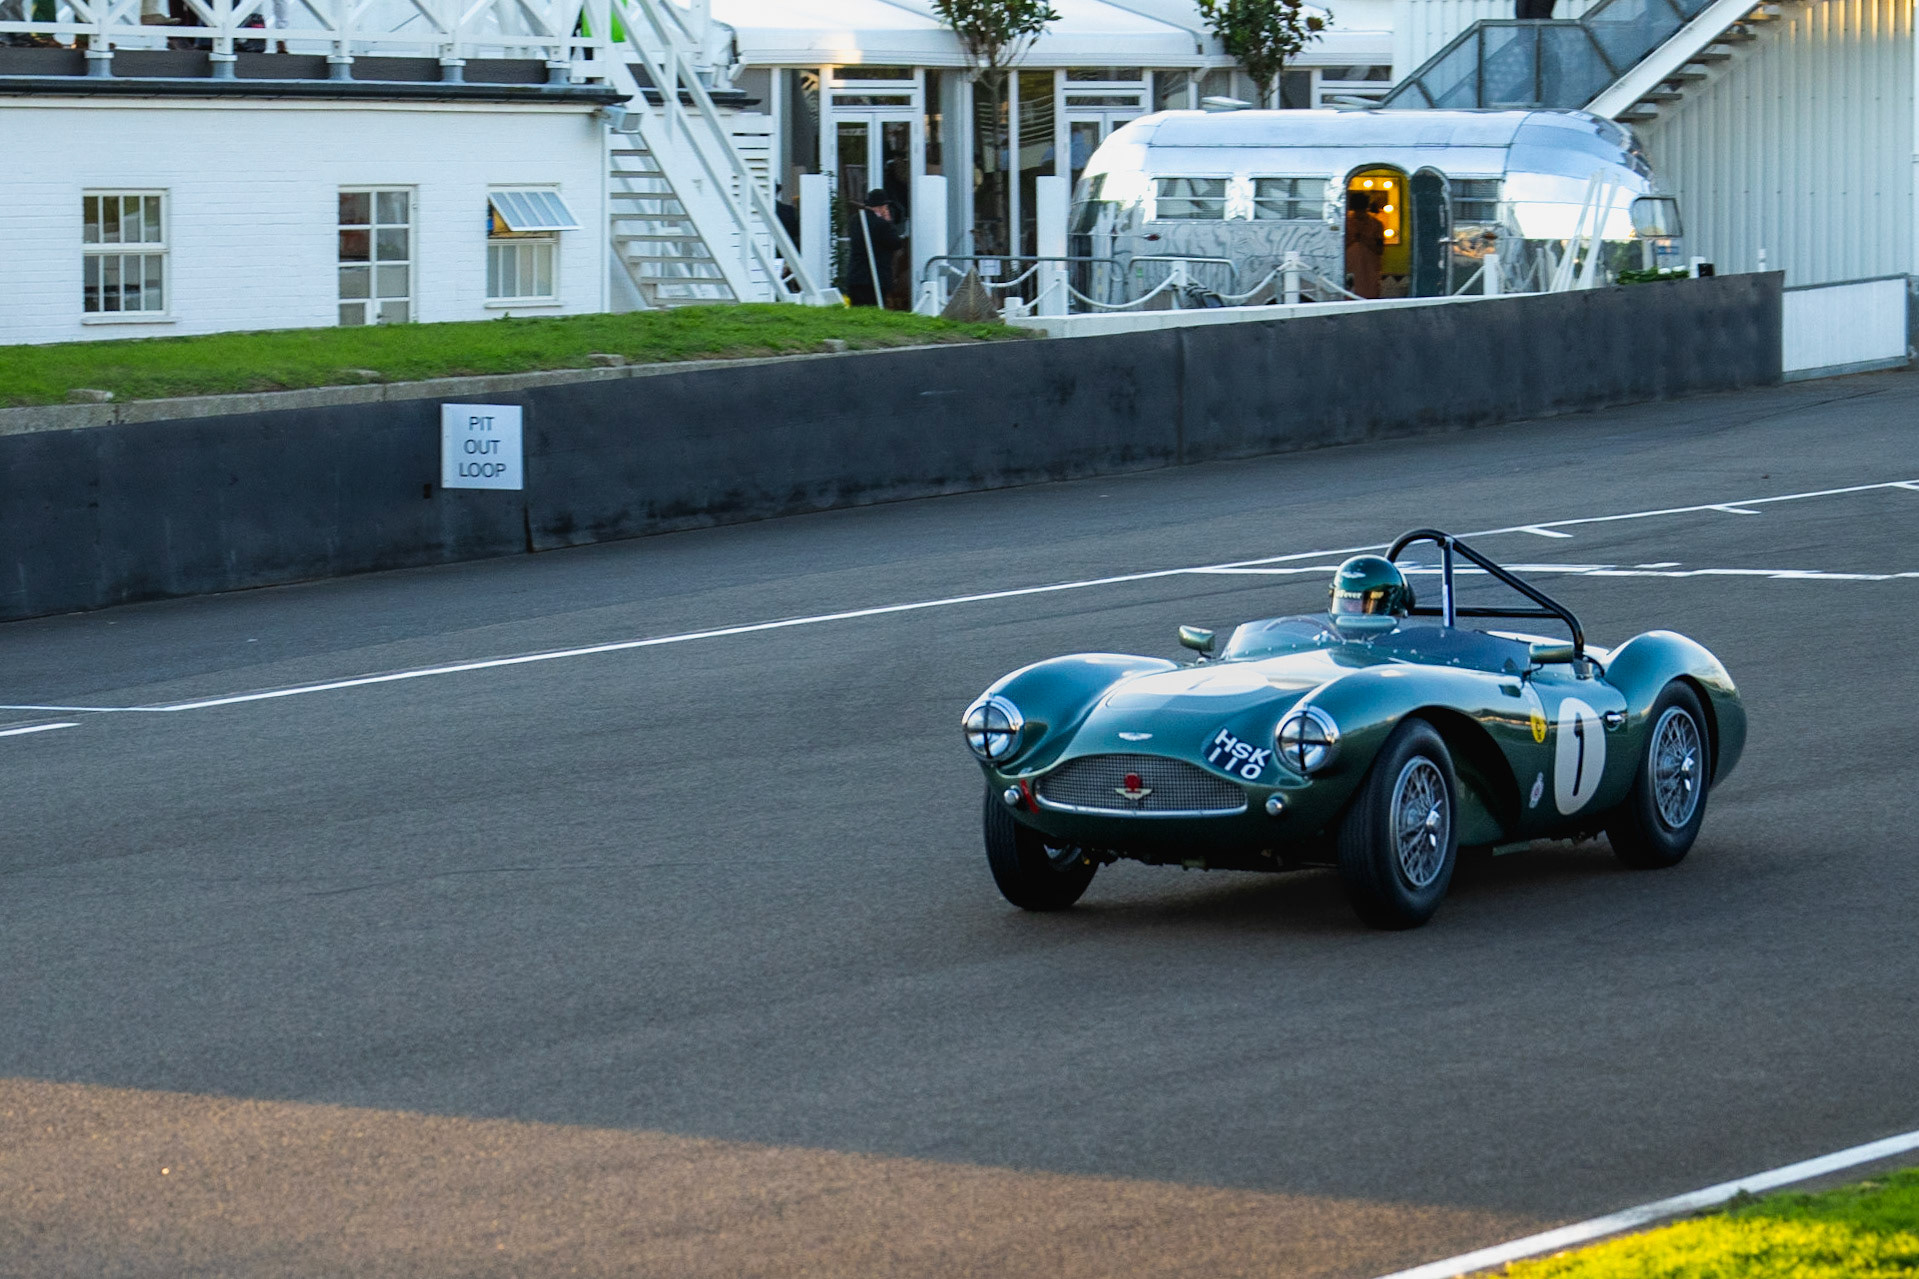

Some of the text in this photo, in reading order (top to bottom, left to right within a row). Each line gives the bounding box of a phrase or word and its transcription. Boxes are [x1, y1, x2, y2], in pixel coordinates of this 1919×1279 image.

[469, 416, 495, 431] PIT
[463, 439, 501, 454] OUT
[459, 462, 507, 478] LOOP
[1214, 728, 1272, 767] HSK
[1573, 712, 1585, 797] 1
[1208, 746, 1262, 780] 110
